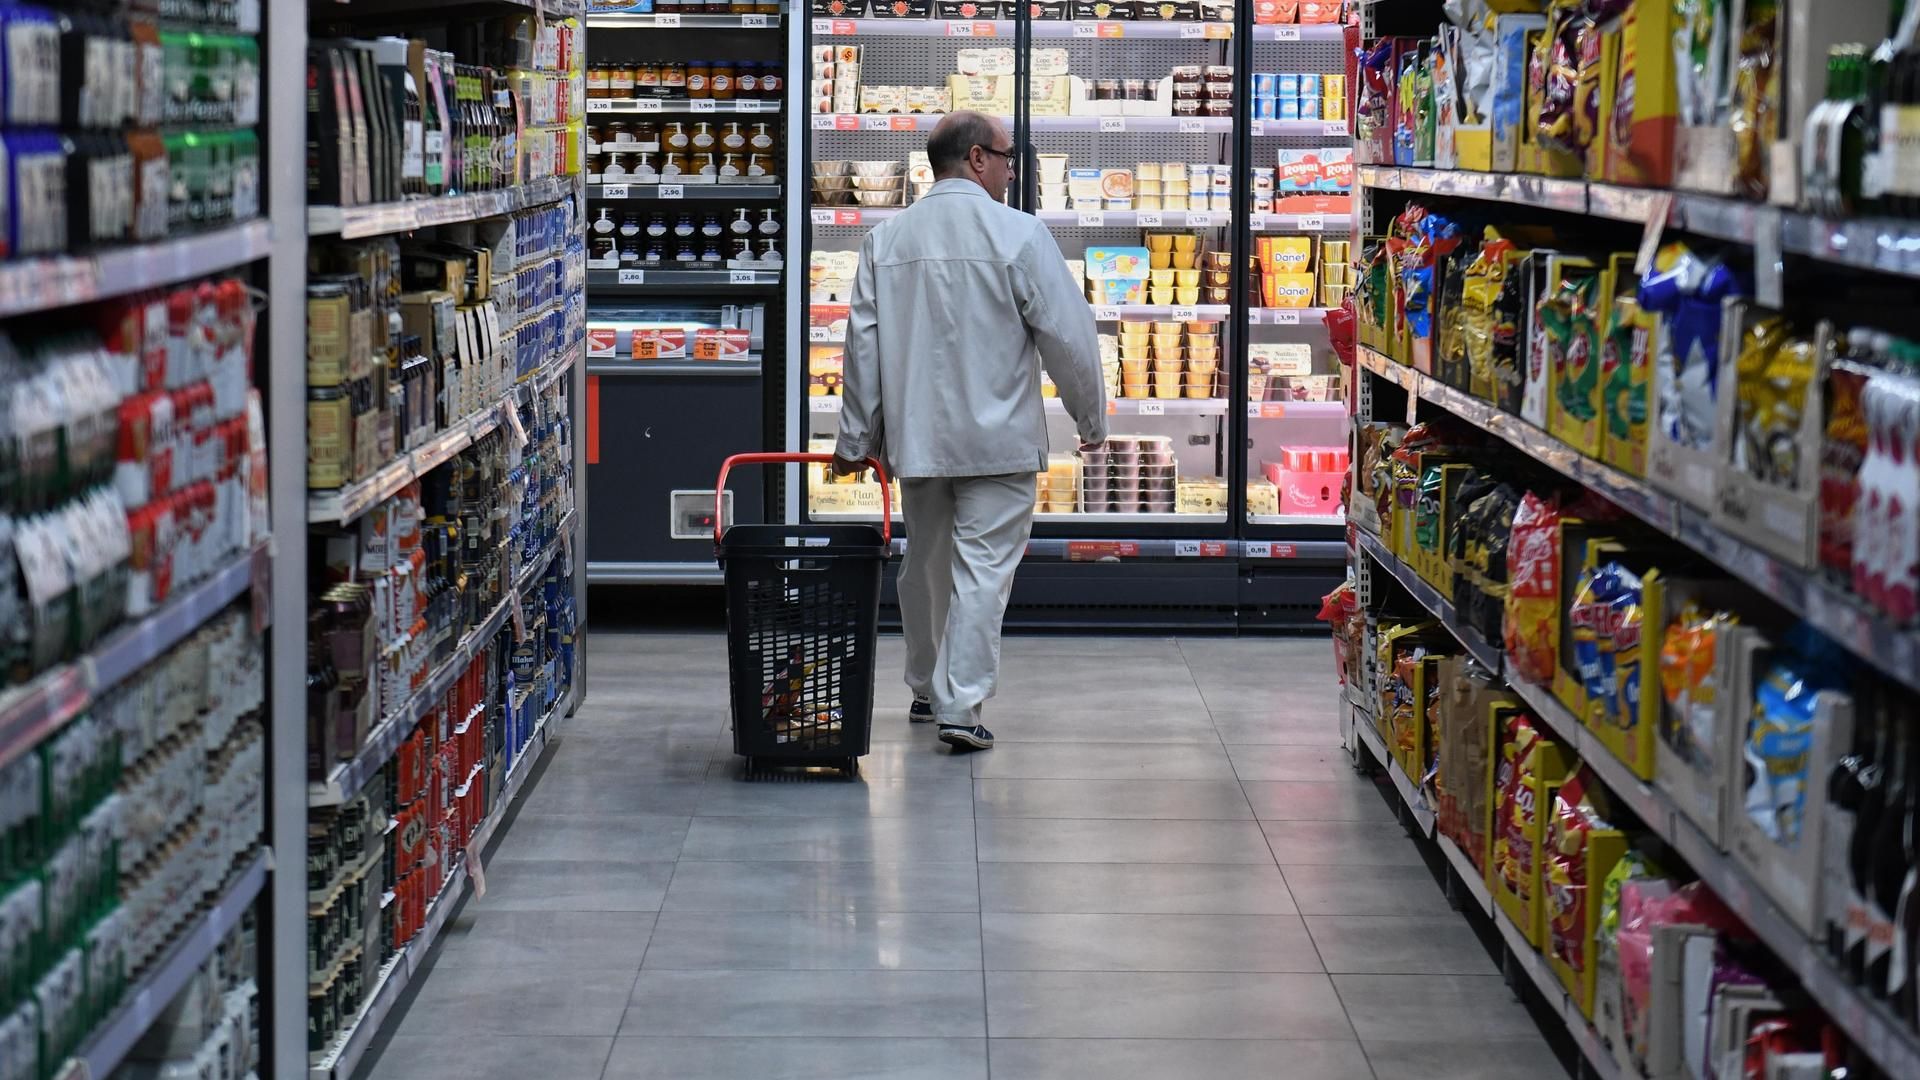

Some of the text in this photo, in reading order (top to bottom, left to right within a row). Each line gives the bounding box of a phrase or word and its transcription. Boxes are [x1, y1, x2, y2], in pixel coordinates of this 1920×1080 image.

[1285, 164, 1318, 176] Royal
[1328, 163, 1353, 176] Roy
[1275, 253, 1305, 262] Danet
[1278, 287, 1309, 296] Danet
